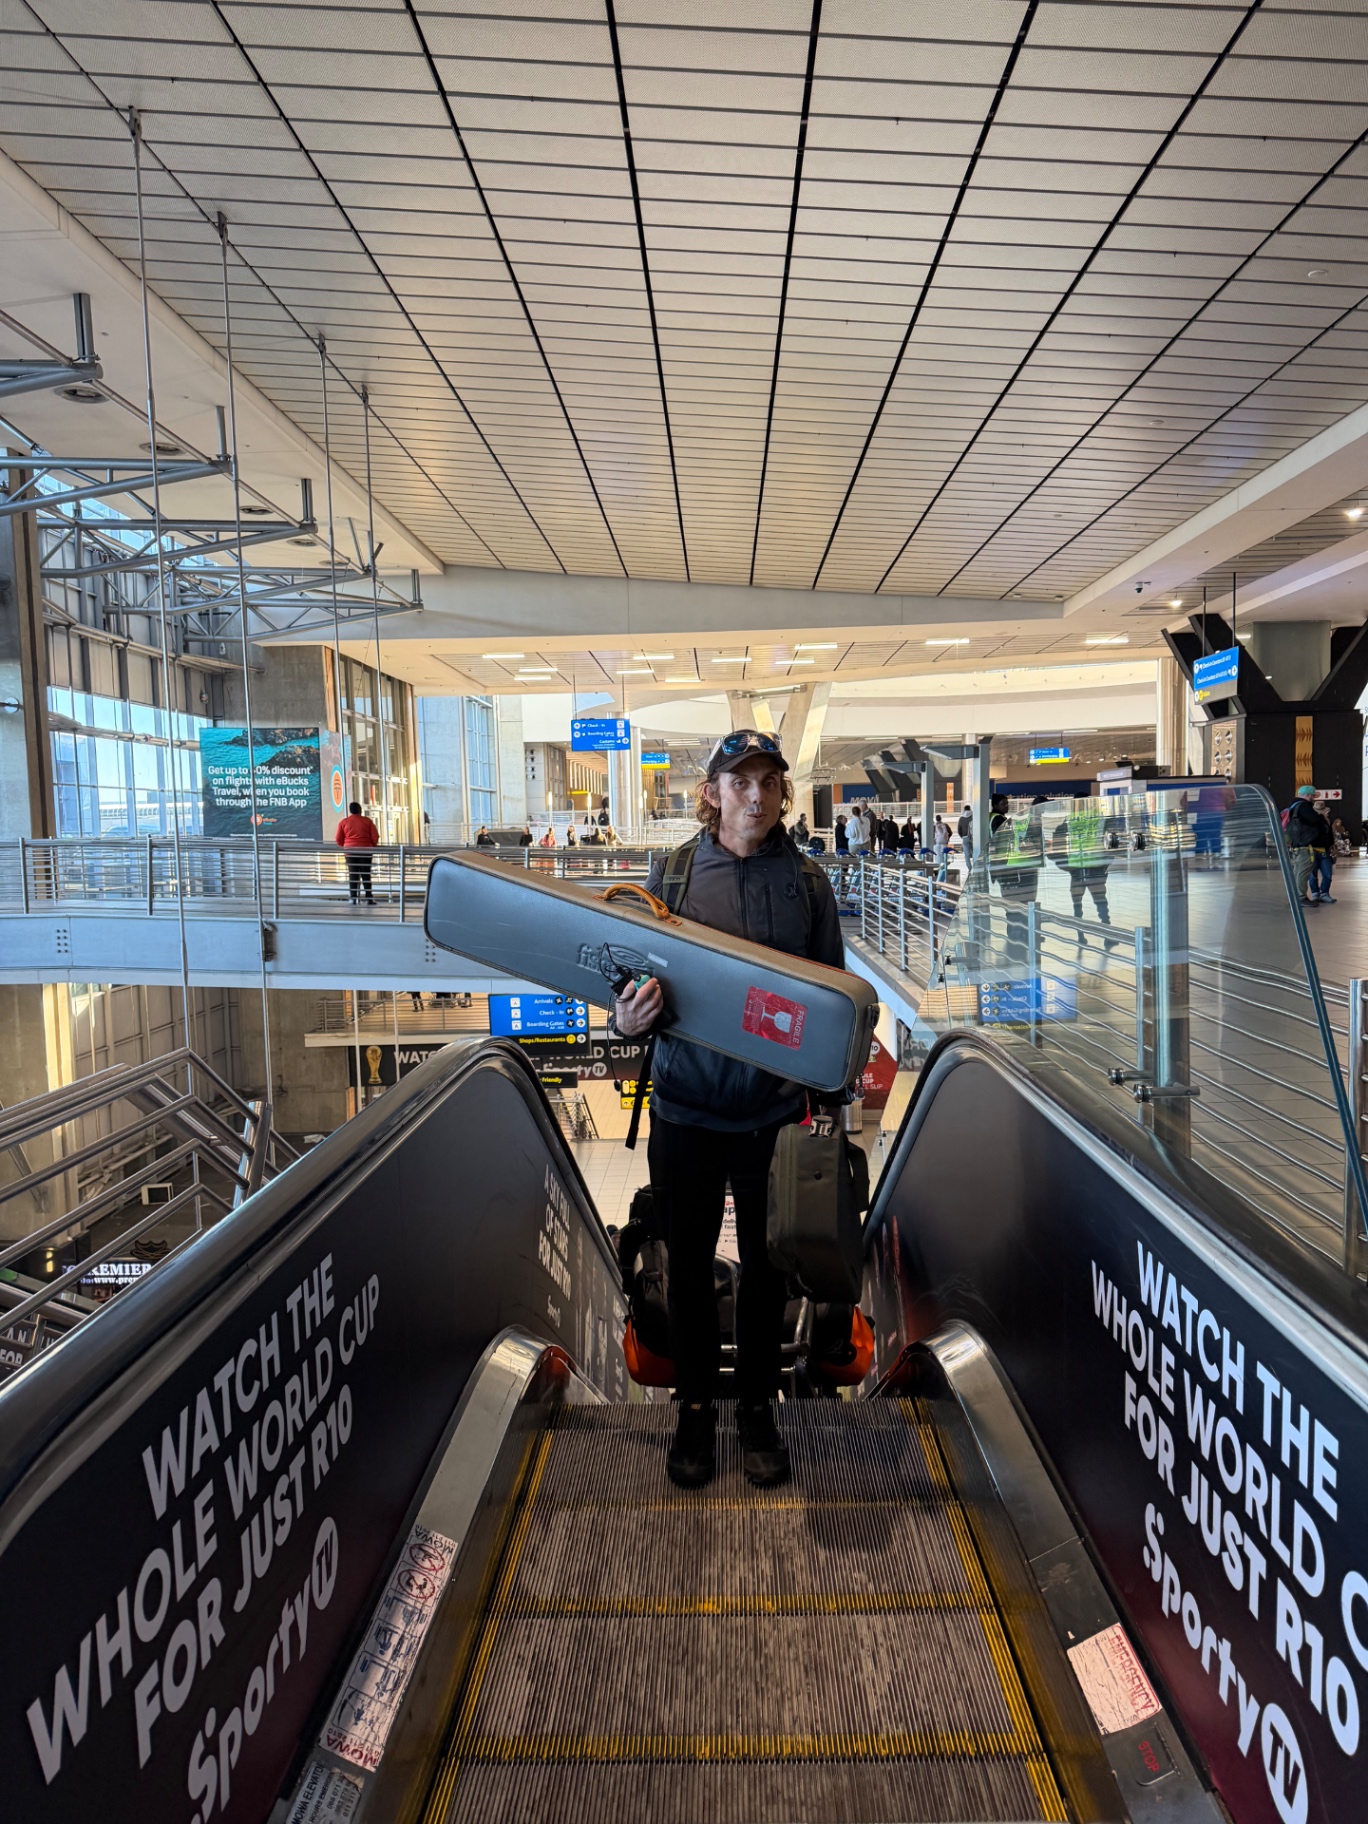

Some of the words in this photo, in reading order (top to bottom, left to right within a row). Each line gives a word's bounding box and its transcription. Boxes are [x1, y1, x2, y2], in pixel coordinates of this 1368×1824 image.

[208, 766, 223, 775] Get
[225, 767, 237, 777] up
[239, 766, 248, 775] to
[250, 766, 270, 775] 0%
[225, 776, 252, 787] flights
[256, 776, 274, 785] with
[276, 776, 309, 785] eBucks
[212, 787, 241, 798] Travel,
[268, 789, 284, 797] you
[286, 787, 309, 796] book
[216, 798, 252, 808] through
[254, 798, 268, 806] he
[269, 798, 288, 806] FNB
[288, 798, 307, 808] App
[793, 1010, 804, 1044] FRAGILE
[610, 1046, 640, 1058] CUP
[550, 1172, 560, 1210] SKY
[546, 1203, 554, 1236] OF
[538, 1230, 550, 1272] FOR
[89, 1263, 152, 1276] REMIER
[142, 1311, 282, 1521] WATCH
[286, 1252, 335, 1355] THE
[1137, 1241, 1244, 1415] WATCH
[1257, 1360, 1339, 1522] THE
[1091, 1259, 1175, 1416] WHOLE
[1183, 1369, 1326, 1598] WORLD
[26, 1479, 218, 1785] WHOLE
[224, 1338, 334, 1521] WORLD
[339, 1273, 380, 1366] CUP
[133, 1577, 226, 1770] FOR
[234, 1446, 306, 1614] JUST
[312, 1384, 354, 1490] R10
[1124, 1370, 1174, 1496] FOR
[1182, 1461, 1267, 1620] JUST
[1276, 1576, 1360, 1756] R10
[1143, 1502, 1260, 1758] Sporty
[1109, 1634, 1155, 1712] EMERGENCY
[188, 1573, 311, 1824] Sporty
[326, 1734, 376, 1766] MOWA
[1138, 1741, 1160, 1773] STOP
[291, 1800, 309, 1824] MOWA
[309, 1800, 323, 1823] HOURS
